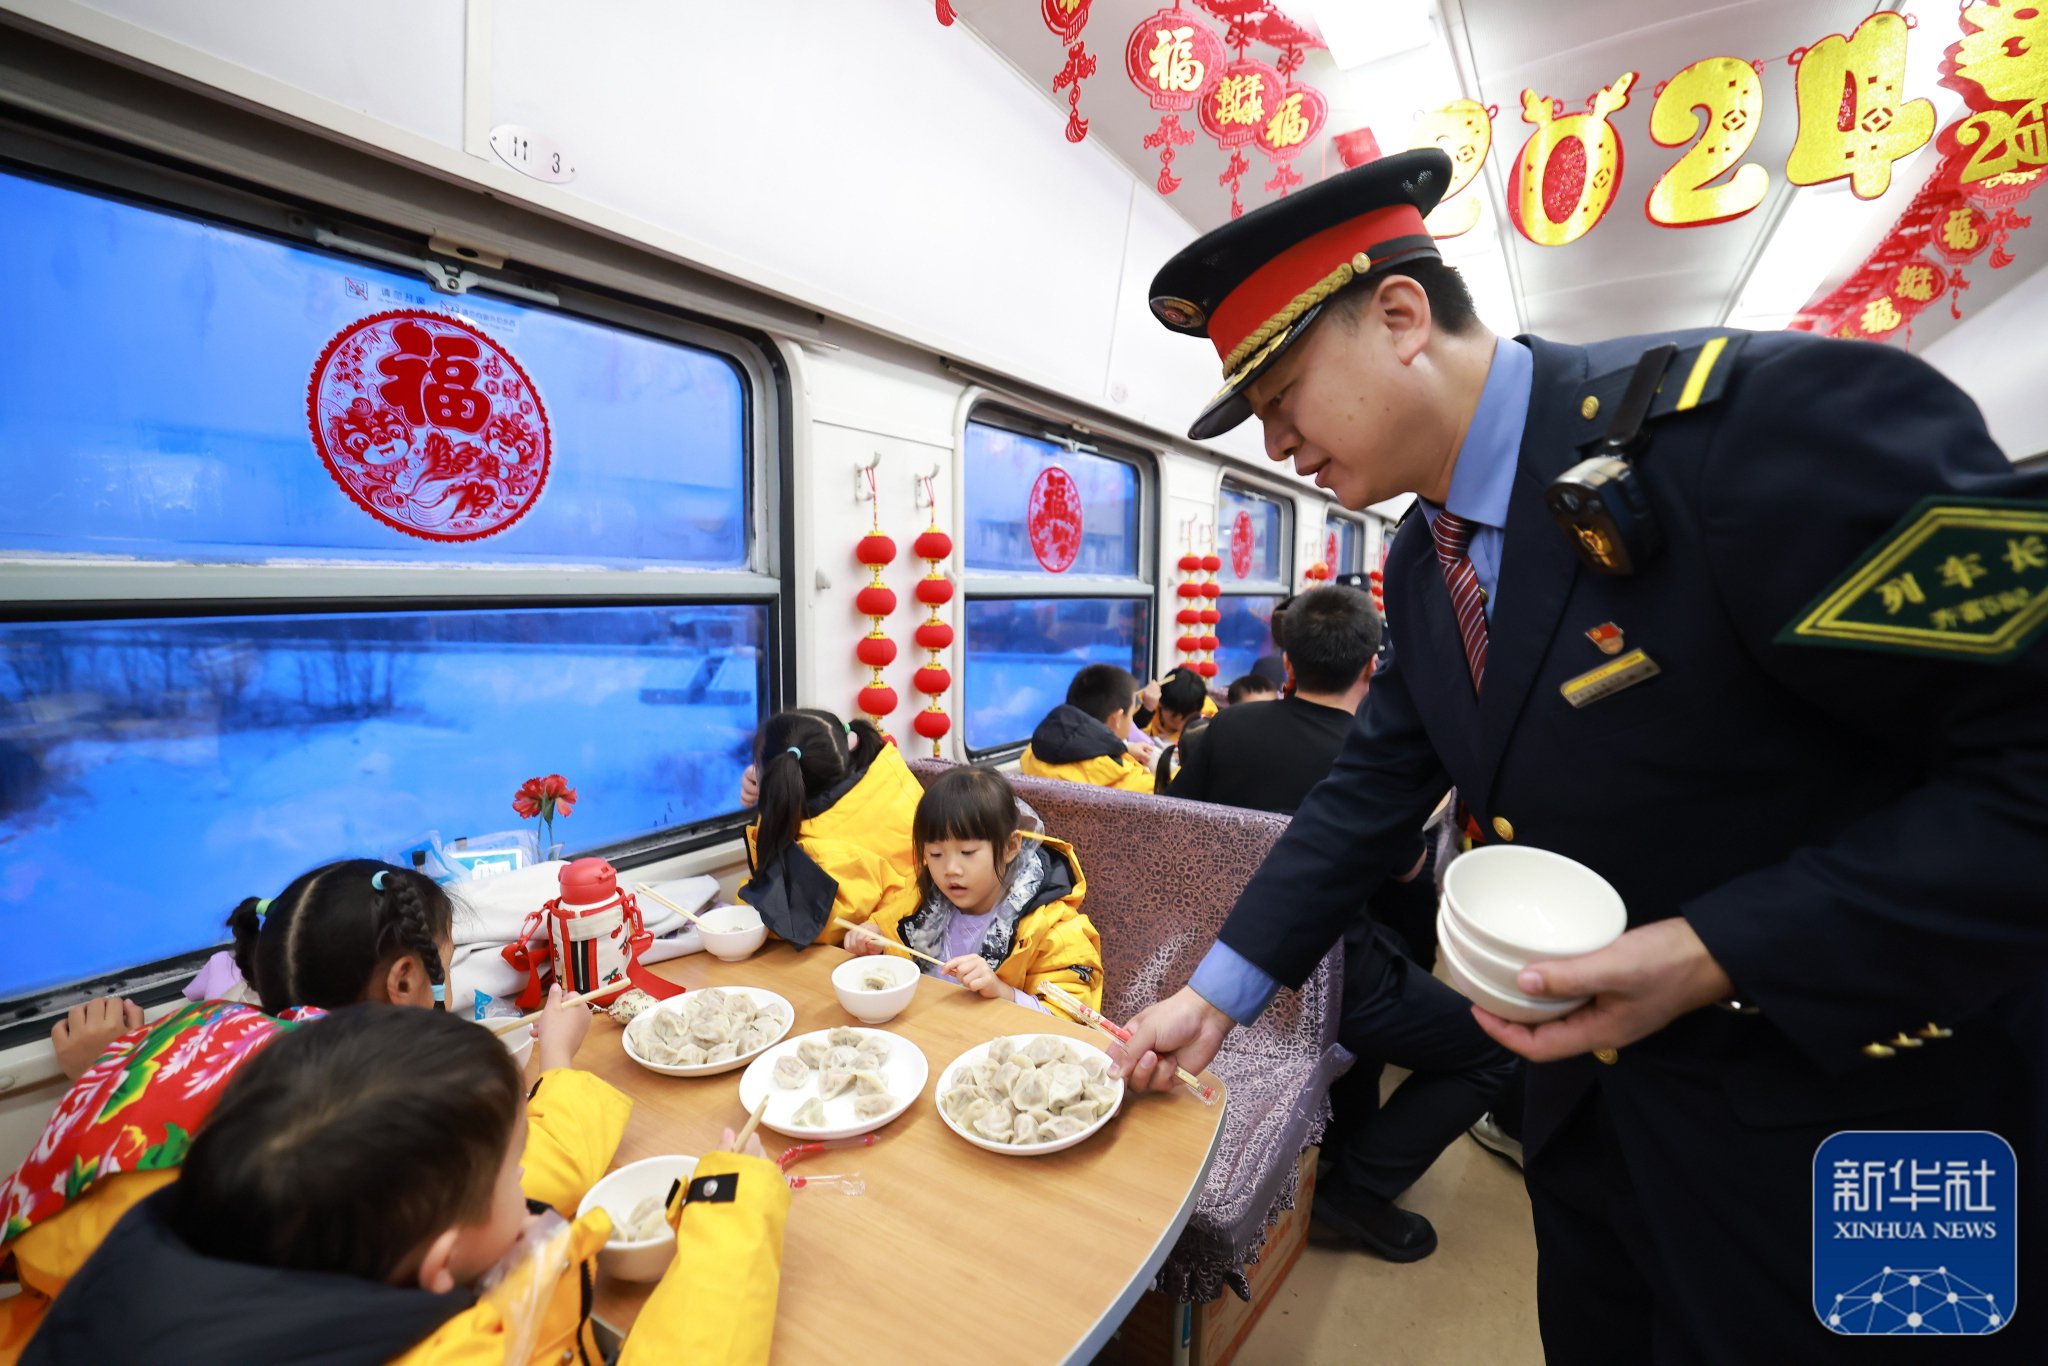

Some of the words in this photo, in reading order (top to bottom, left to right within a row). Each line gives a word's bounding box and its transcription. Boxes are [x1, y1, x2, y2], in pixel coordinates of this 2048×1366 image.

[1149, 26, 1205, 92] 福
[1266, 93, 1310, 147] 福
[552, 152, 561, 174] 3
[376, 320, 493, 434] 福
[1875, 535, 2048, 615] 列车长
